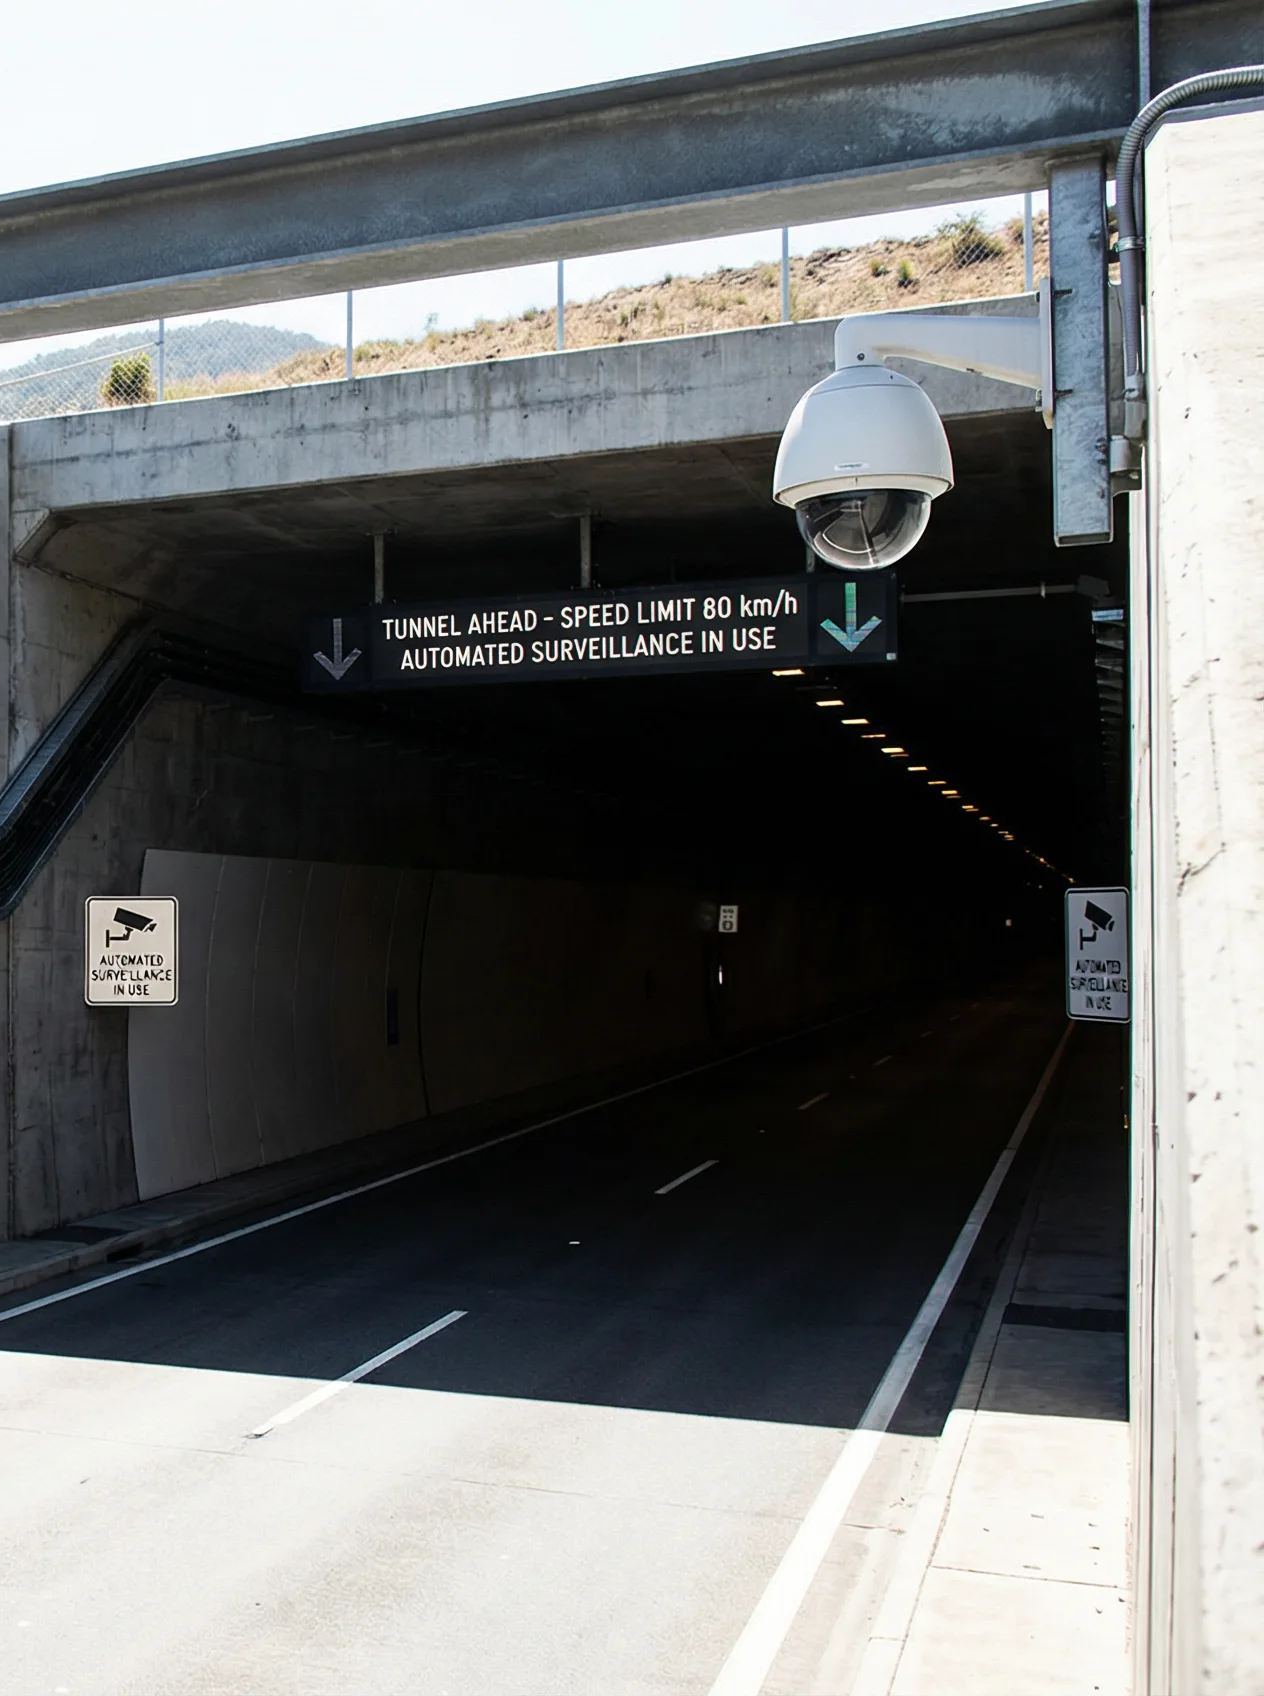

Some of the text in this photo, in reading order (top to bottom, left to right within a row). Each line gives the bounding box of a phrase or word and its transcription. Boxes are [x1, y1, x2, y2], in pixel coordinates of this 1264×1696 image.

[382, 614, 462, 640] TUNNEL
[468, 609, 538, 635] AHEAD
[560, 603, 630, 629] SPEED
[637, 598, 696, 624] LIMIT
[703, 596, 732, 620] 80
[740, 589, 798, 618] km/h
[400, 626, 777, 670] AUTOMATED SURVEILLANCE IN USE
[113, 984, 150, 996] IN USE
